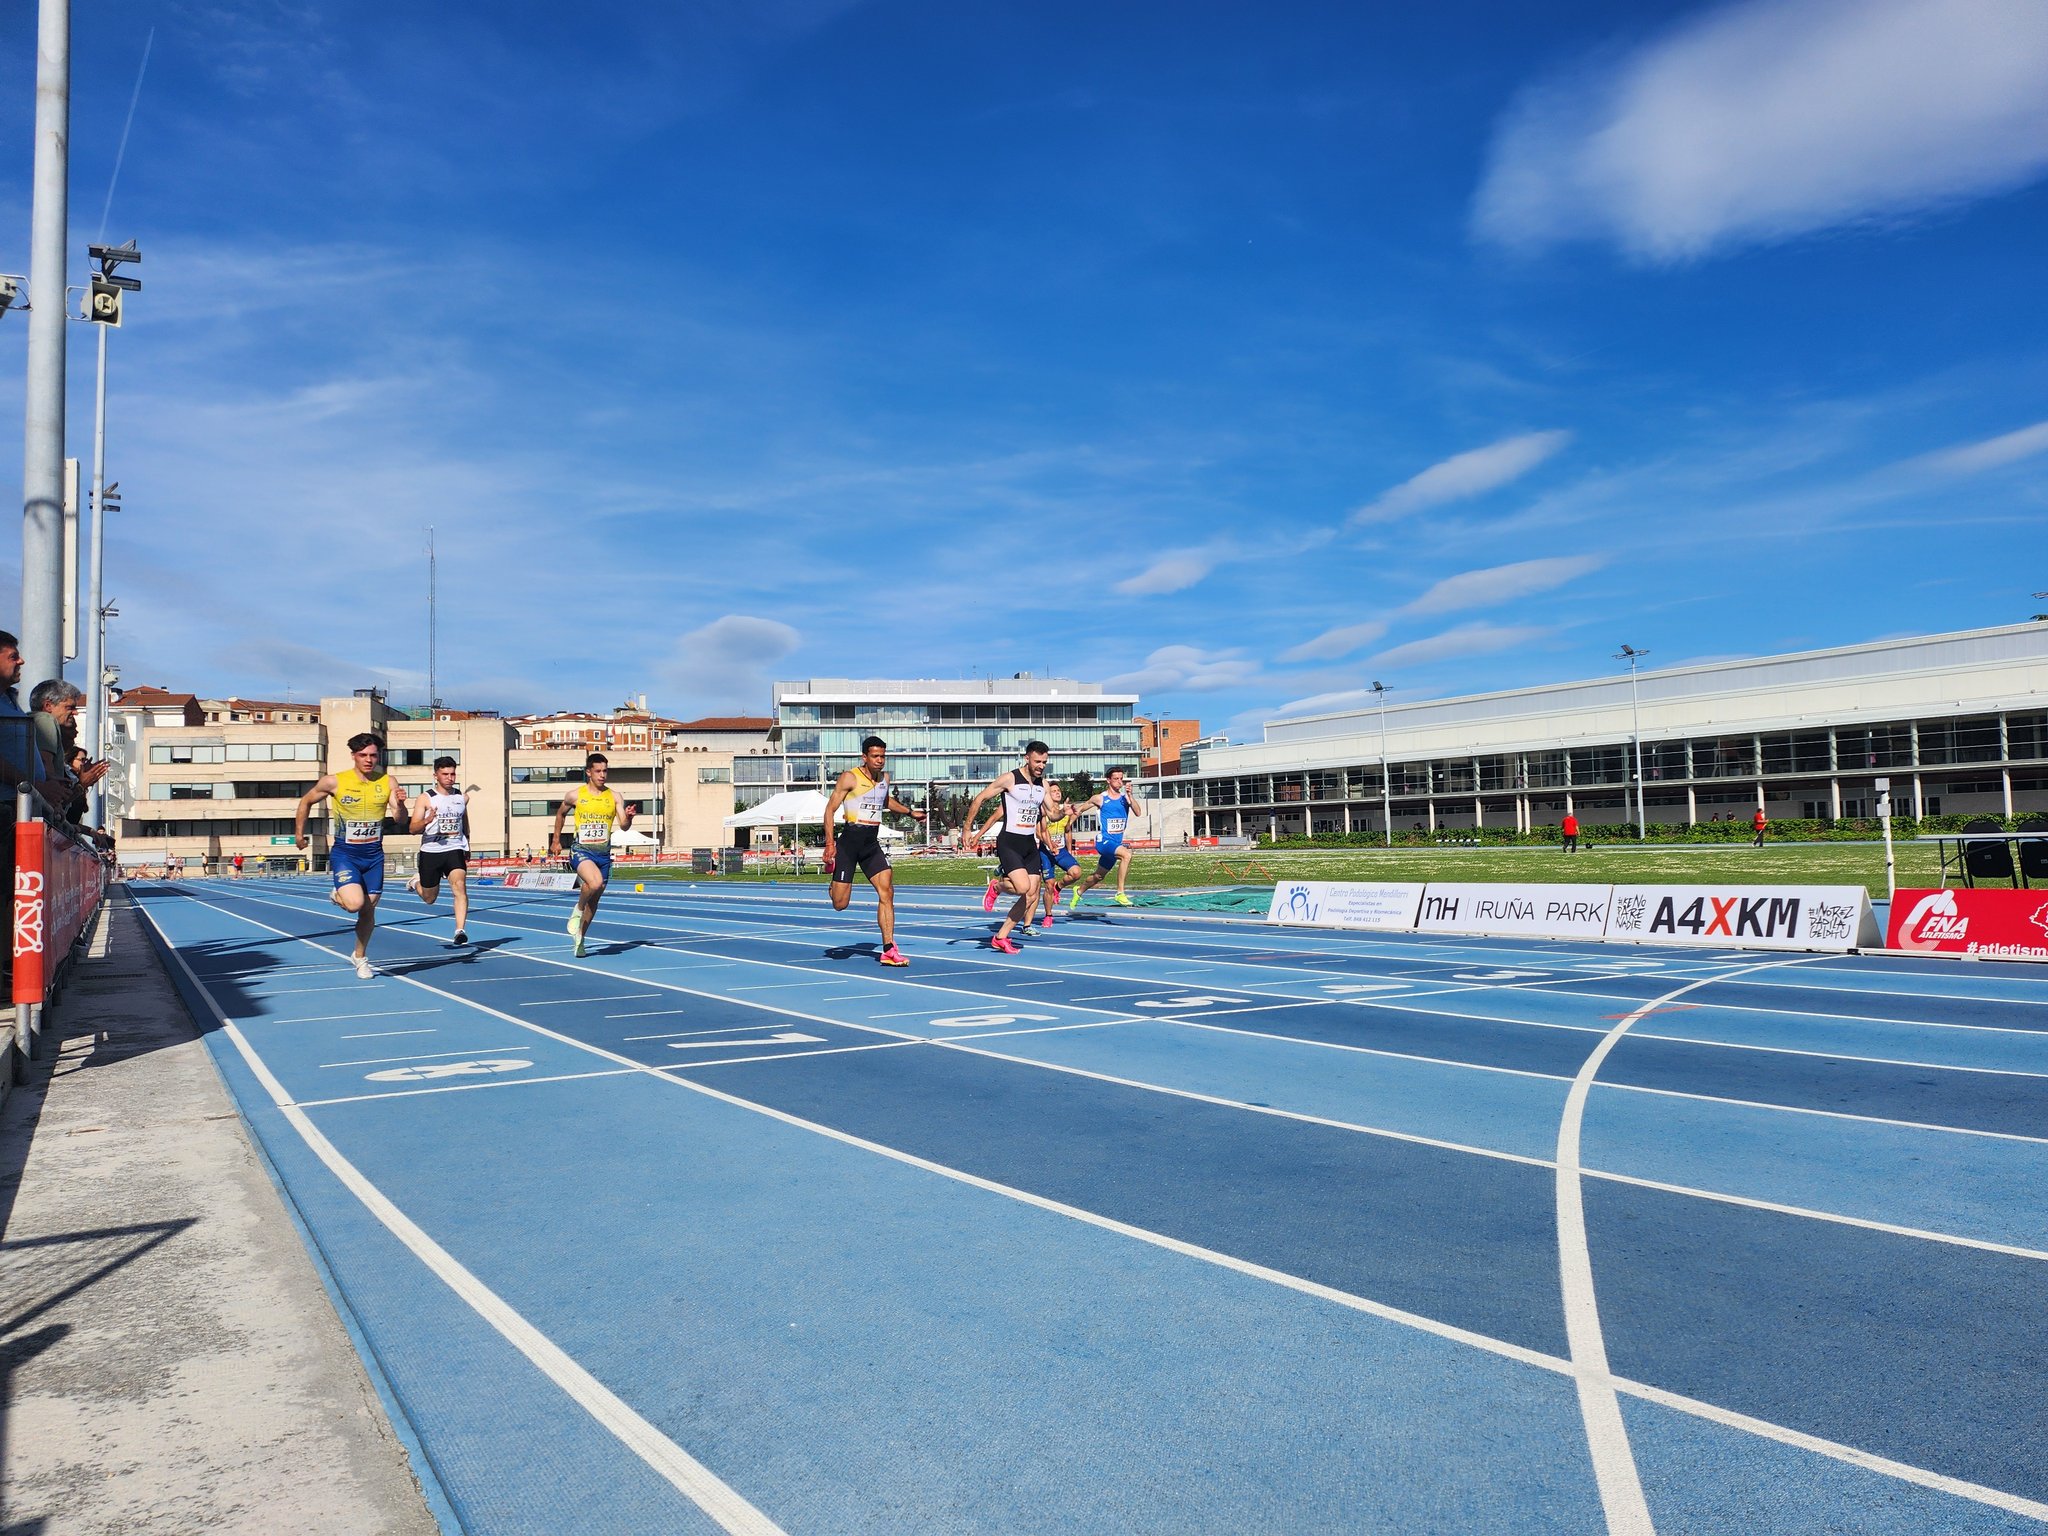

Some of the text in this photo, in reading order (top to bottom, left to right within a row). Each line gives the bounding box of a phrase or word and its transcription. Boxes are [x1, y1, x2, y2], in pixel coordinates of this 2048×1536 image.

[869, 811, 877, 819] 7
[1020, 815, 1037, 823] 560
[441, 823, 459, 831] 536
[352, 828, 377, 837] 446
[584, 829, 604, 838] 433
[1475, 897, 1605, 923] IRUÑA PARK
[1648, 896, 1801, 938] A4XKM
[1922, 916, 1970, 932] FNA
[1917, 931, 1966, 940] ATLETISMO
[1966, 941, 2048, 957] #atletism
